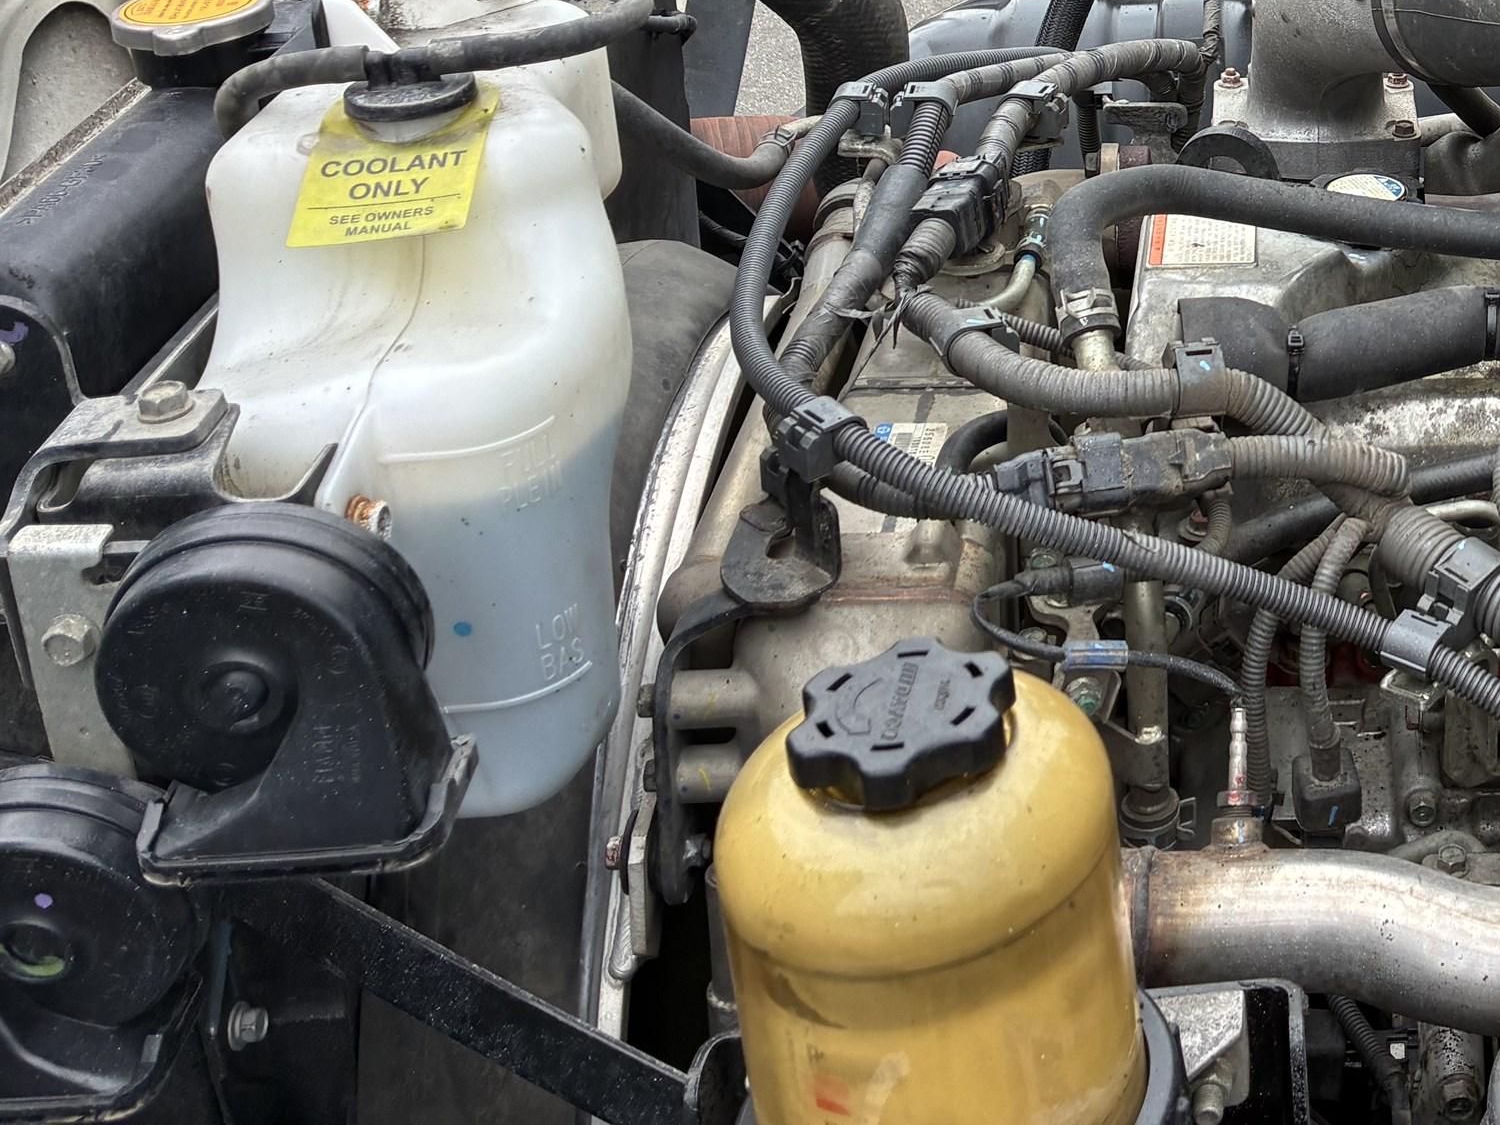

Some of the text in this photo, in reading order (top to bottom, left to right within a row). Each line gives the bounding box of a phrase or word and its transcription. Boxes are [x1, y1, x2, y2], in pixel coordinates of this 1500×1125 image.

[321, 150, 468, 178] COOLANT
[348, 176, 430, 201] ONLY
[329, 206, 434, 226] SEE OWNERS
[344, 221, 412, 237] MANUAL
[535, 602, 580, 650] LOW
[541, 636, 585, 681] BAS
